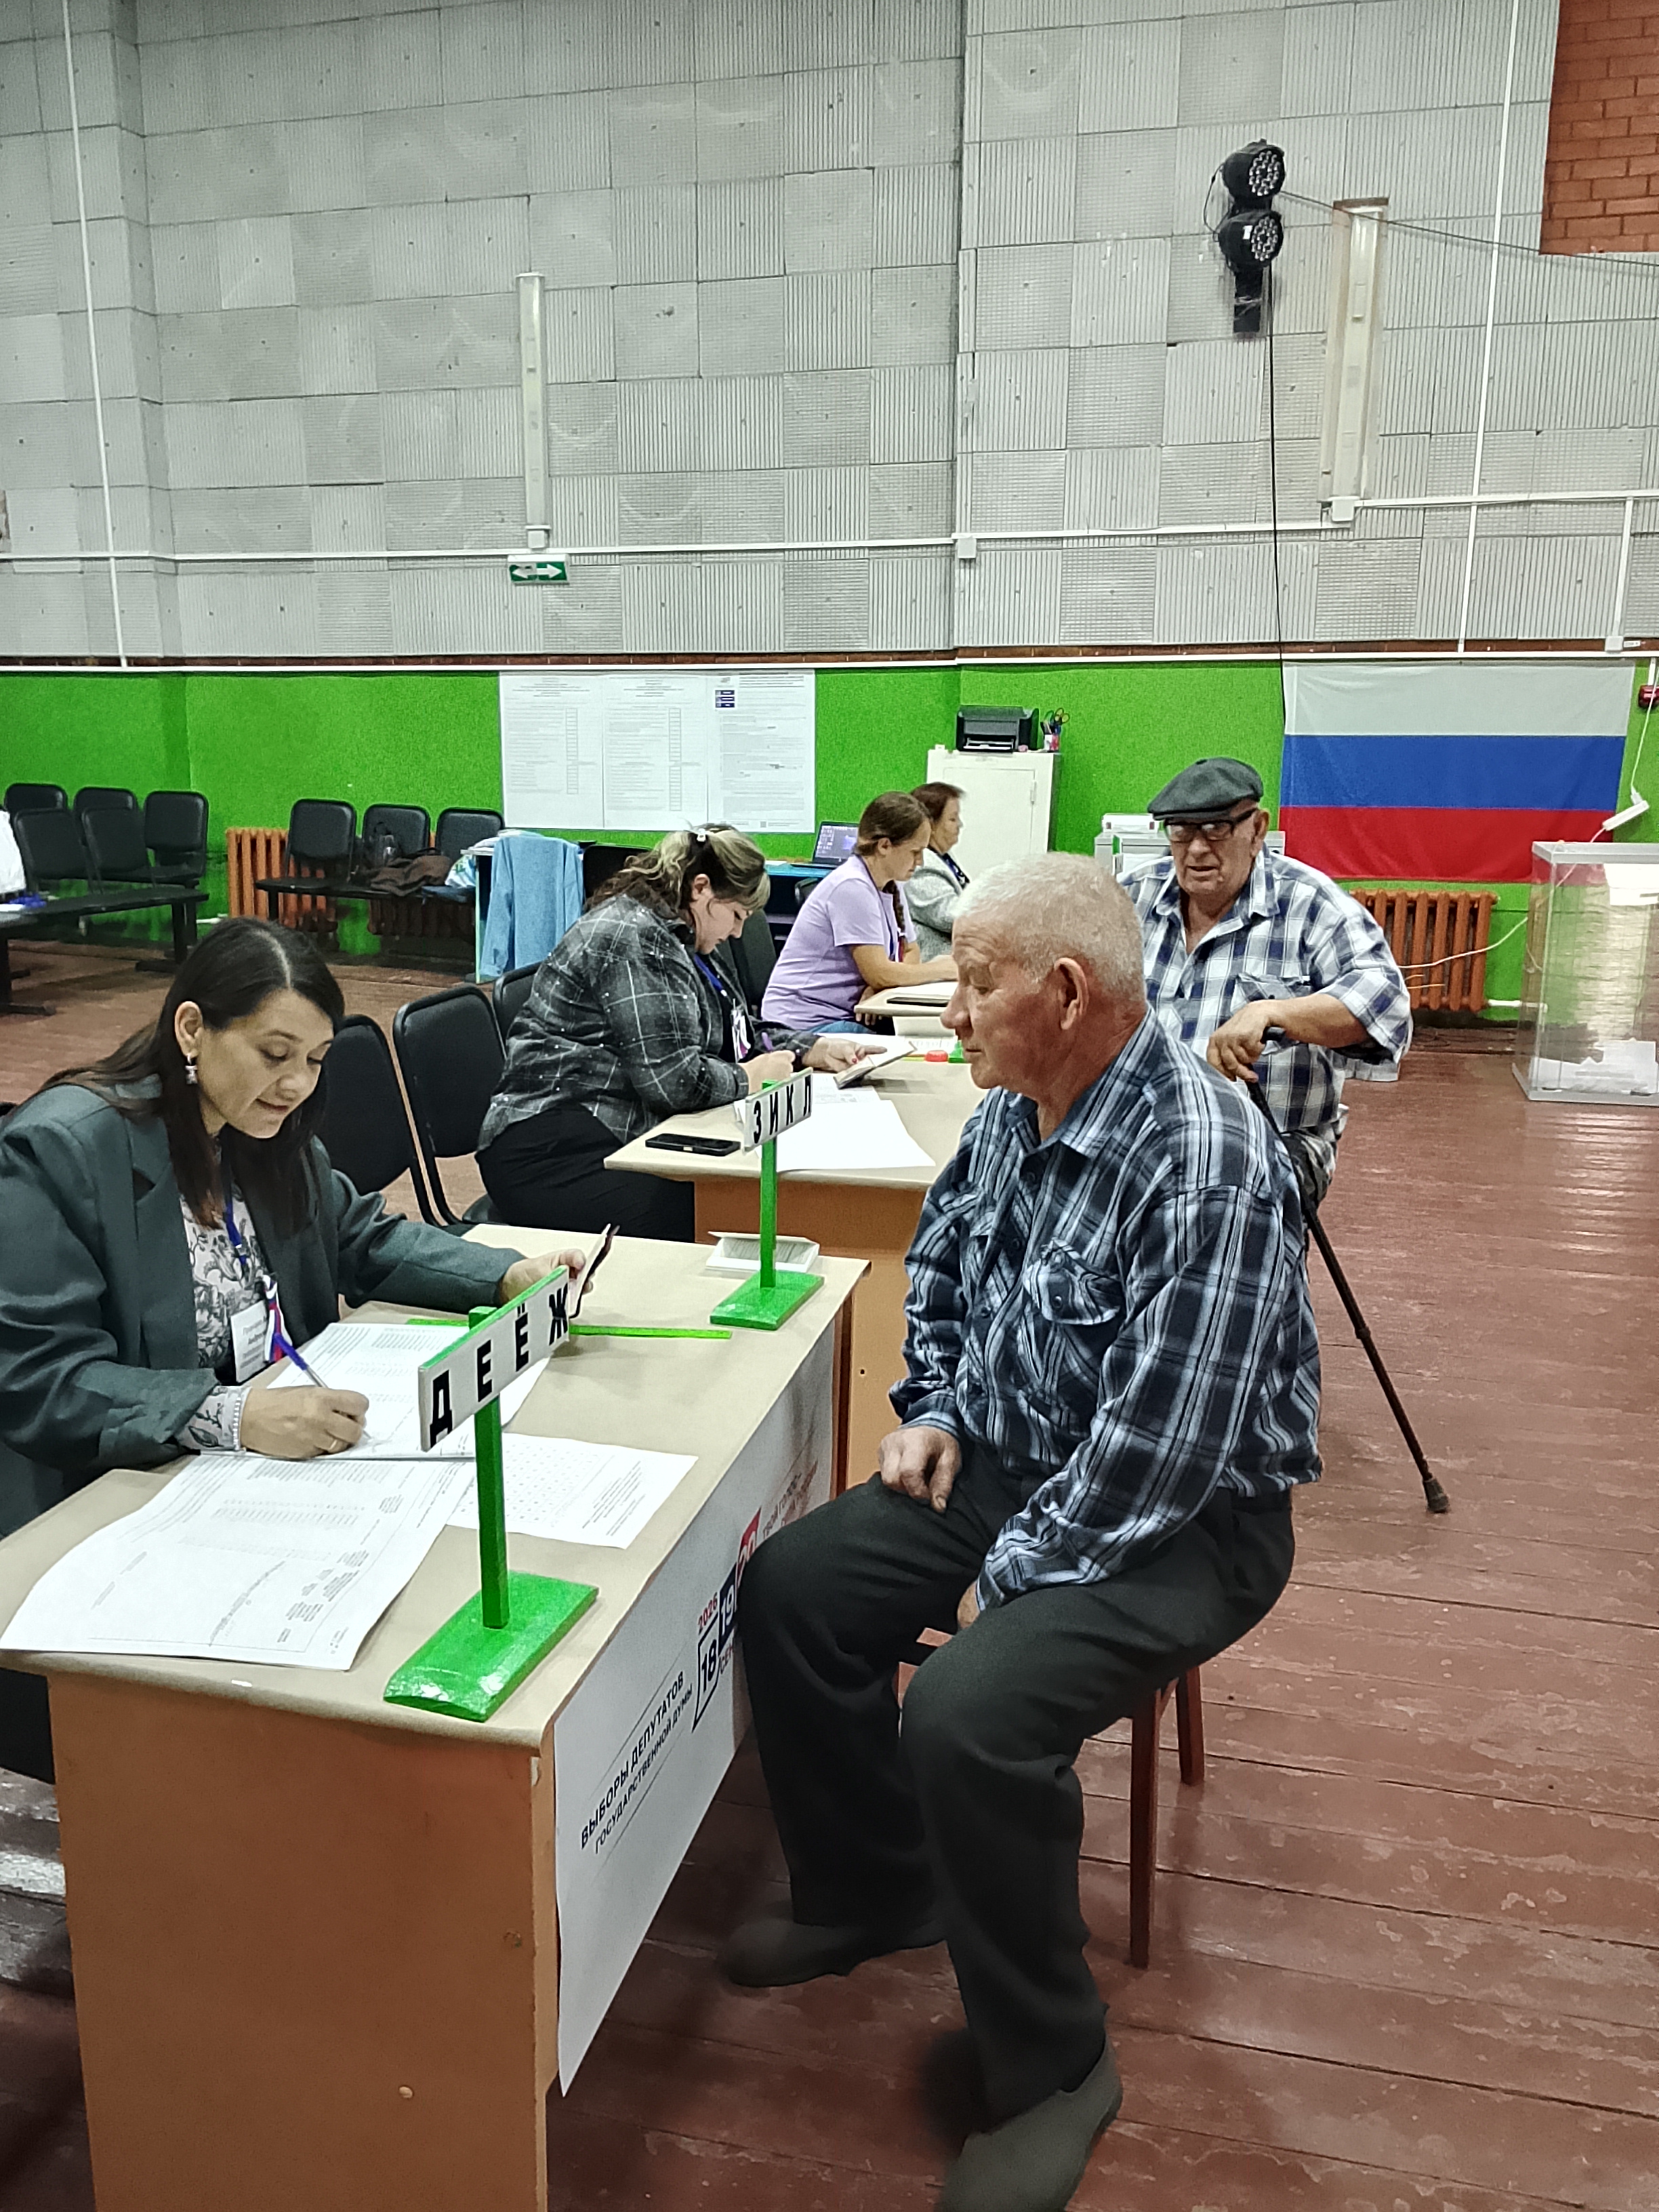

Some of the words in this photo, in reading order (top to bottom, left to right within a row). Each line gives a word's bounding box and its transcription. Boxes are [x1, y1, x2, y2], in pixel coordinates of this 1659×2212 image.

[753, 1101, 762, 1144] З
[769, 1091, 779, 1136] И
[786, 1083, 794, 1126] К
[803, 1074, 811, 1117] Л
[430, 1369, 453, 1448] Д
[476, 1339, 493, 1403] Е
[515, 1303, 529, 1373] Ё
[549, 1282, 568, 1346] Ж
[698, 1592, 718, 1635] 2026
[721, 1584, 734, 1636] 19
[701, 1639, 716, 1693] 18
[581, 1759, 629, 1850] ВЫБОРЫ
[631, 1671, 684, 1774] ДЕПУТАТОВ
[595, 1718, 672, 1854] ГОСУДАРСТВЕННОЙ
[672, 1683, 693, 1729] ДУМЫ
